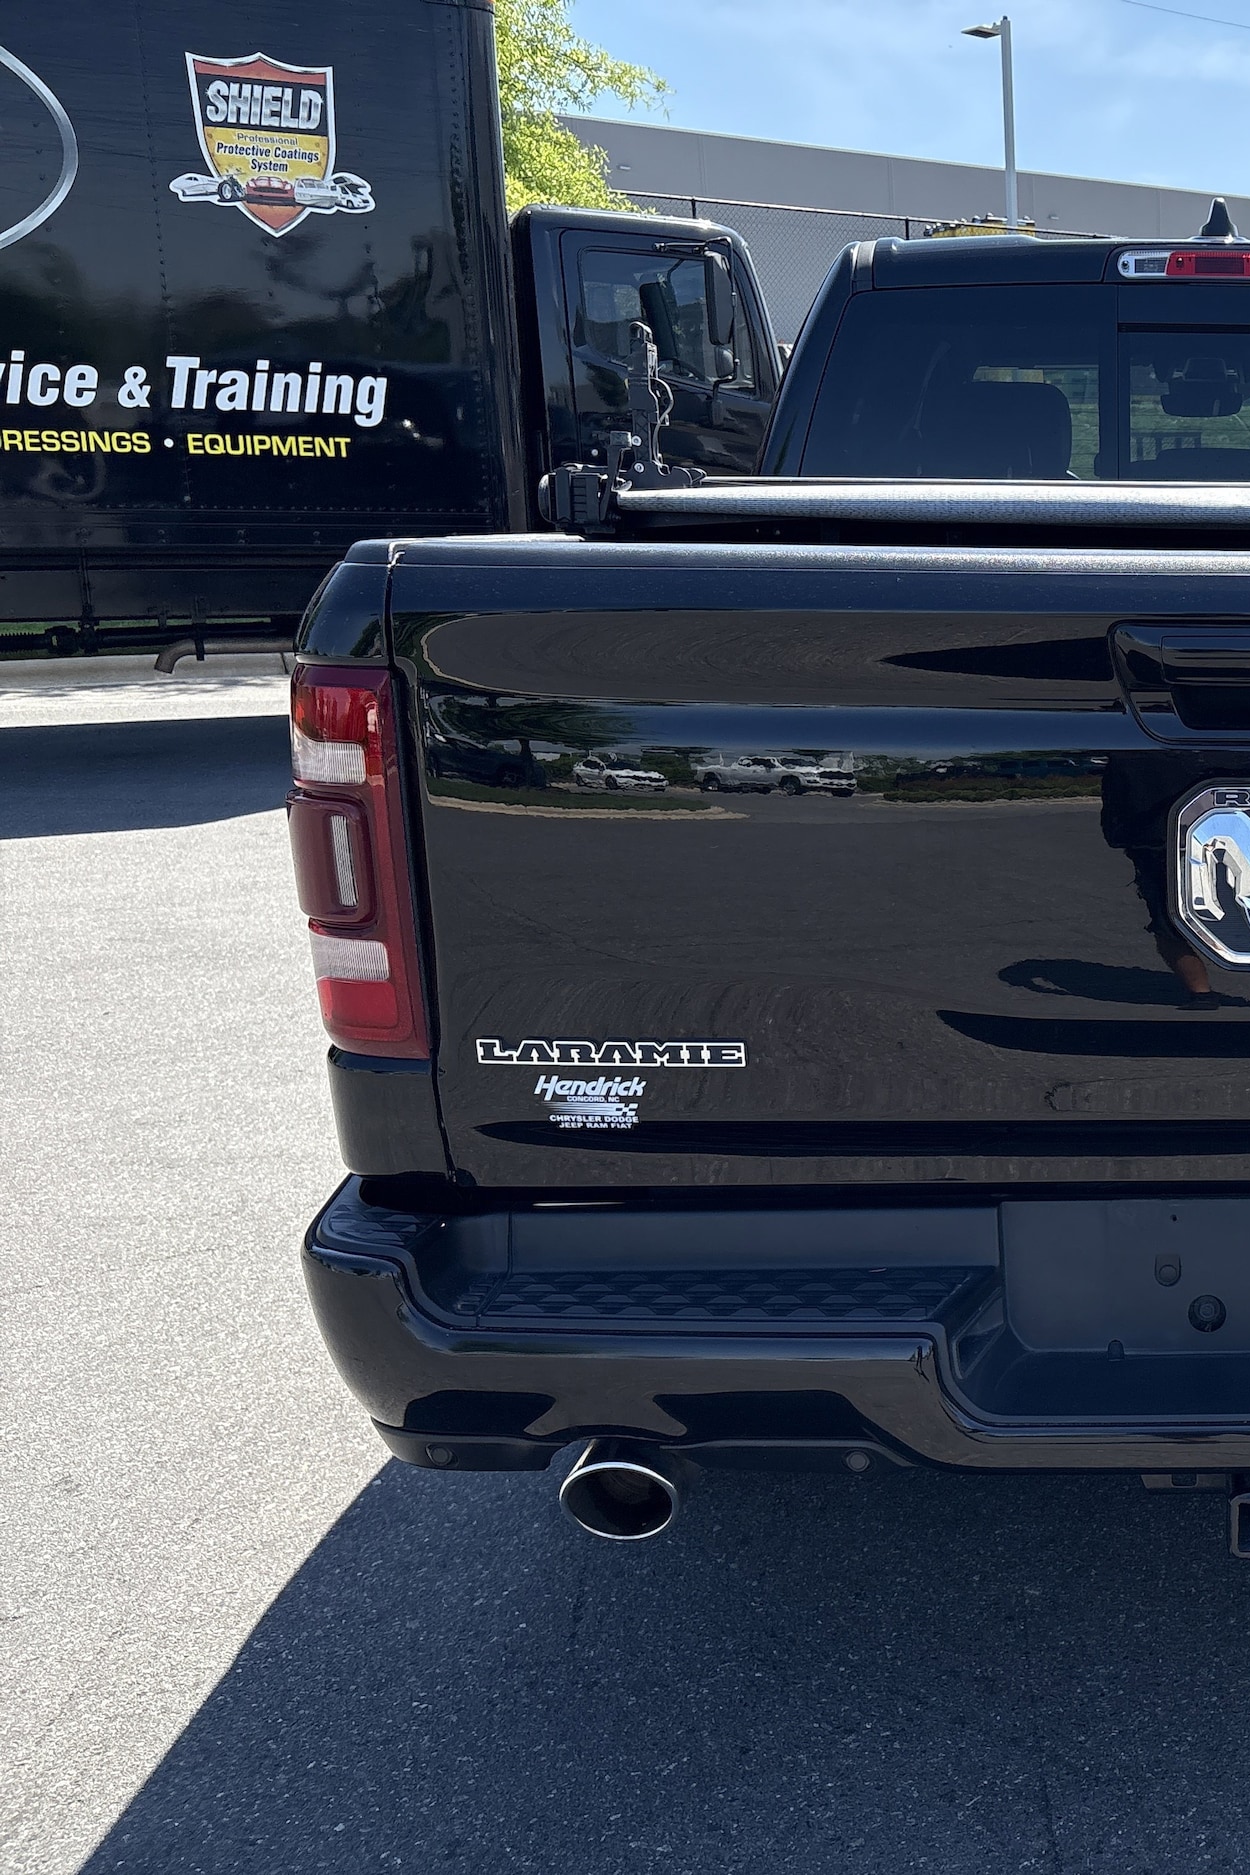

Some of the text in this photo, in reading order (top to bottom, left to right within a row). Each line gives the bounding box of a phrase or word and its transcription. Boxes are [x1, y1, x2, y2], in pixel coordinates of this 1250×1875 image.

[206, 80, 323, 130] SHIELD
[236, 132, 298, 146] Professional
[216, 142, 319, 163] Protective Coatings
[250, 159, 288, 173] System
[0, 350, 388, 427] ice & Training
[0, 429, 351, 458] RESSINGS EQUIPMENT
[476, 1038, 746, 1068] LARAMIE
[534, 1075, 647, 1101] Hendrick
[549, 1114, 639, 1124] CHRYSLER DODGE
